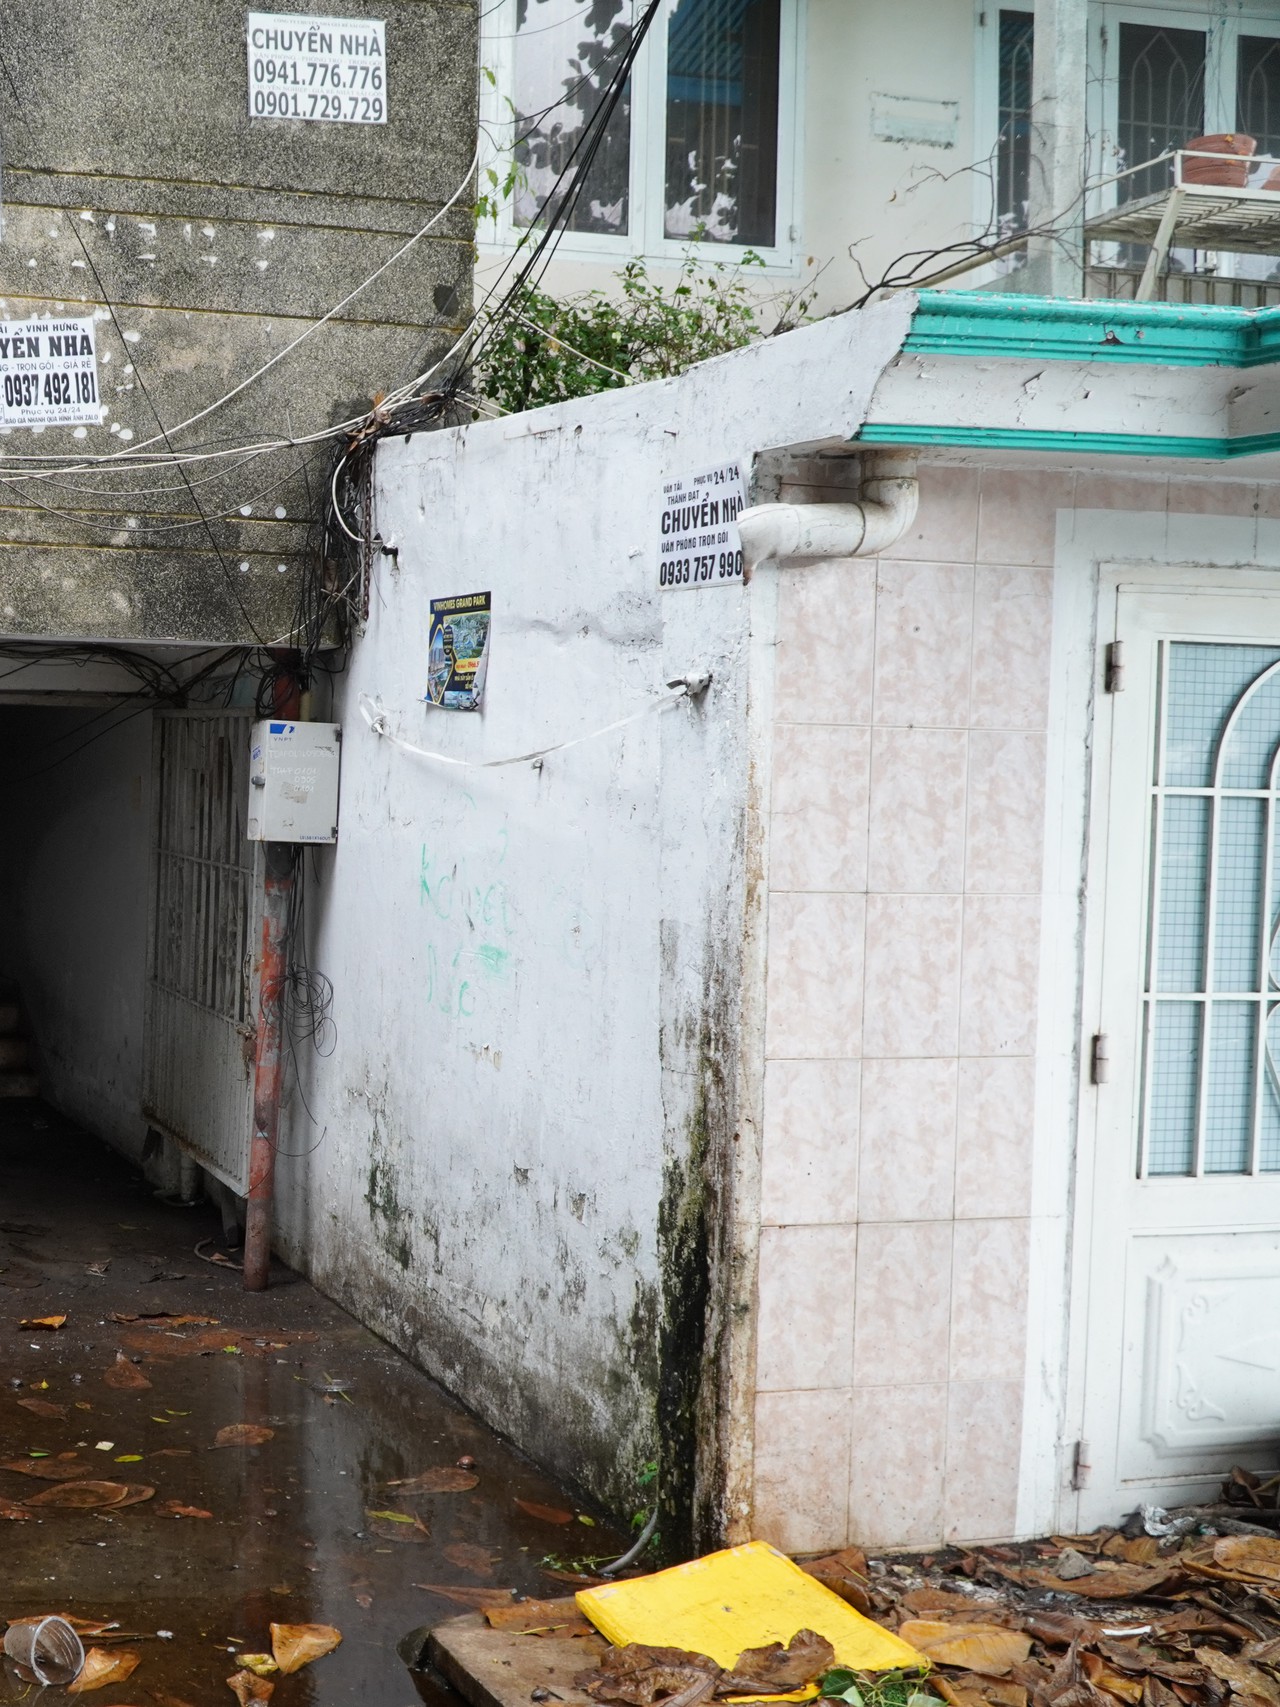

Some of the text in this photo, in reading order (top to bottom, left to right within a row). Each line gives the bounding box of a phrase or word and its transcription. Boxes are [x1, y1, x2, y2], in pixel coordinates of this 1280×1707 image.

[252, 25, 382, 57] CHUYỂN NHÀ
[254, 58, 383, 90] 0941.776.776
[254, 90, 383, 121] 0901.729.729
[25, 323, 49, 333] VINH
[52, 322, 79, 332] HƯNG
[48, 328, 93, 357] NHÀ
[16, 363, 37, 372] TRỌN
[39, 360, 55, 371] GÓI
[63, 359, 79, 370] GIÁ
[81, 357, 92, 369] RẺ
[21, 408, 42, 416] Phục
[58, 406, 81, 415] 24/24
[693, 475, 706, 487] PHỤC
[713, 465, 740, 485] 24/24
[687, 489, 700, 503] ĐẠT
[661, 491, 719, 535] CHUYỂN
[661, 530, 729, 553] VĂN PHÒNG TRỌN GÓI
[660, 549, 743, 586] 0933 757 990
[456, 597, 473, 608] GRAND
[473, 595, 486, 606] PARK
